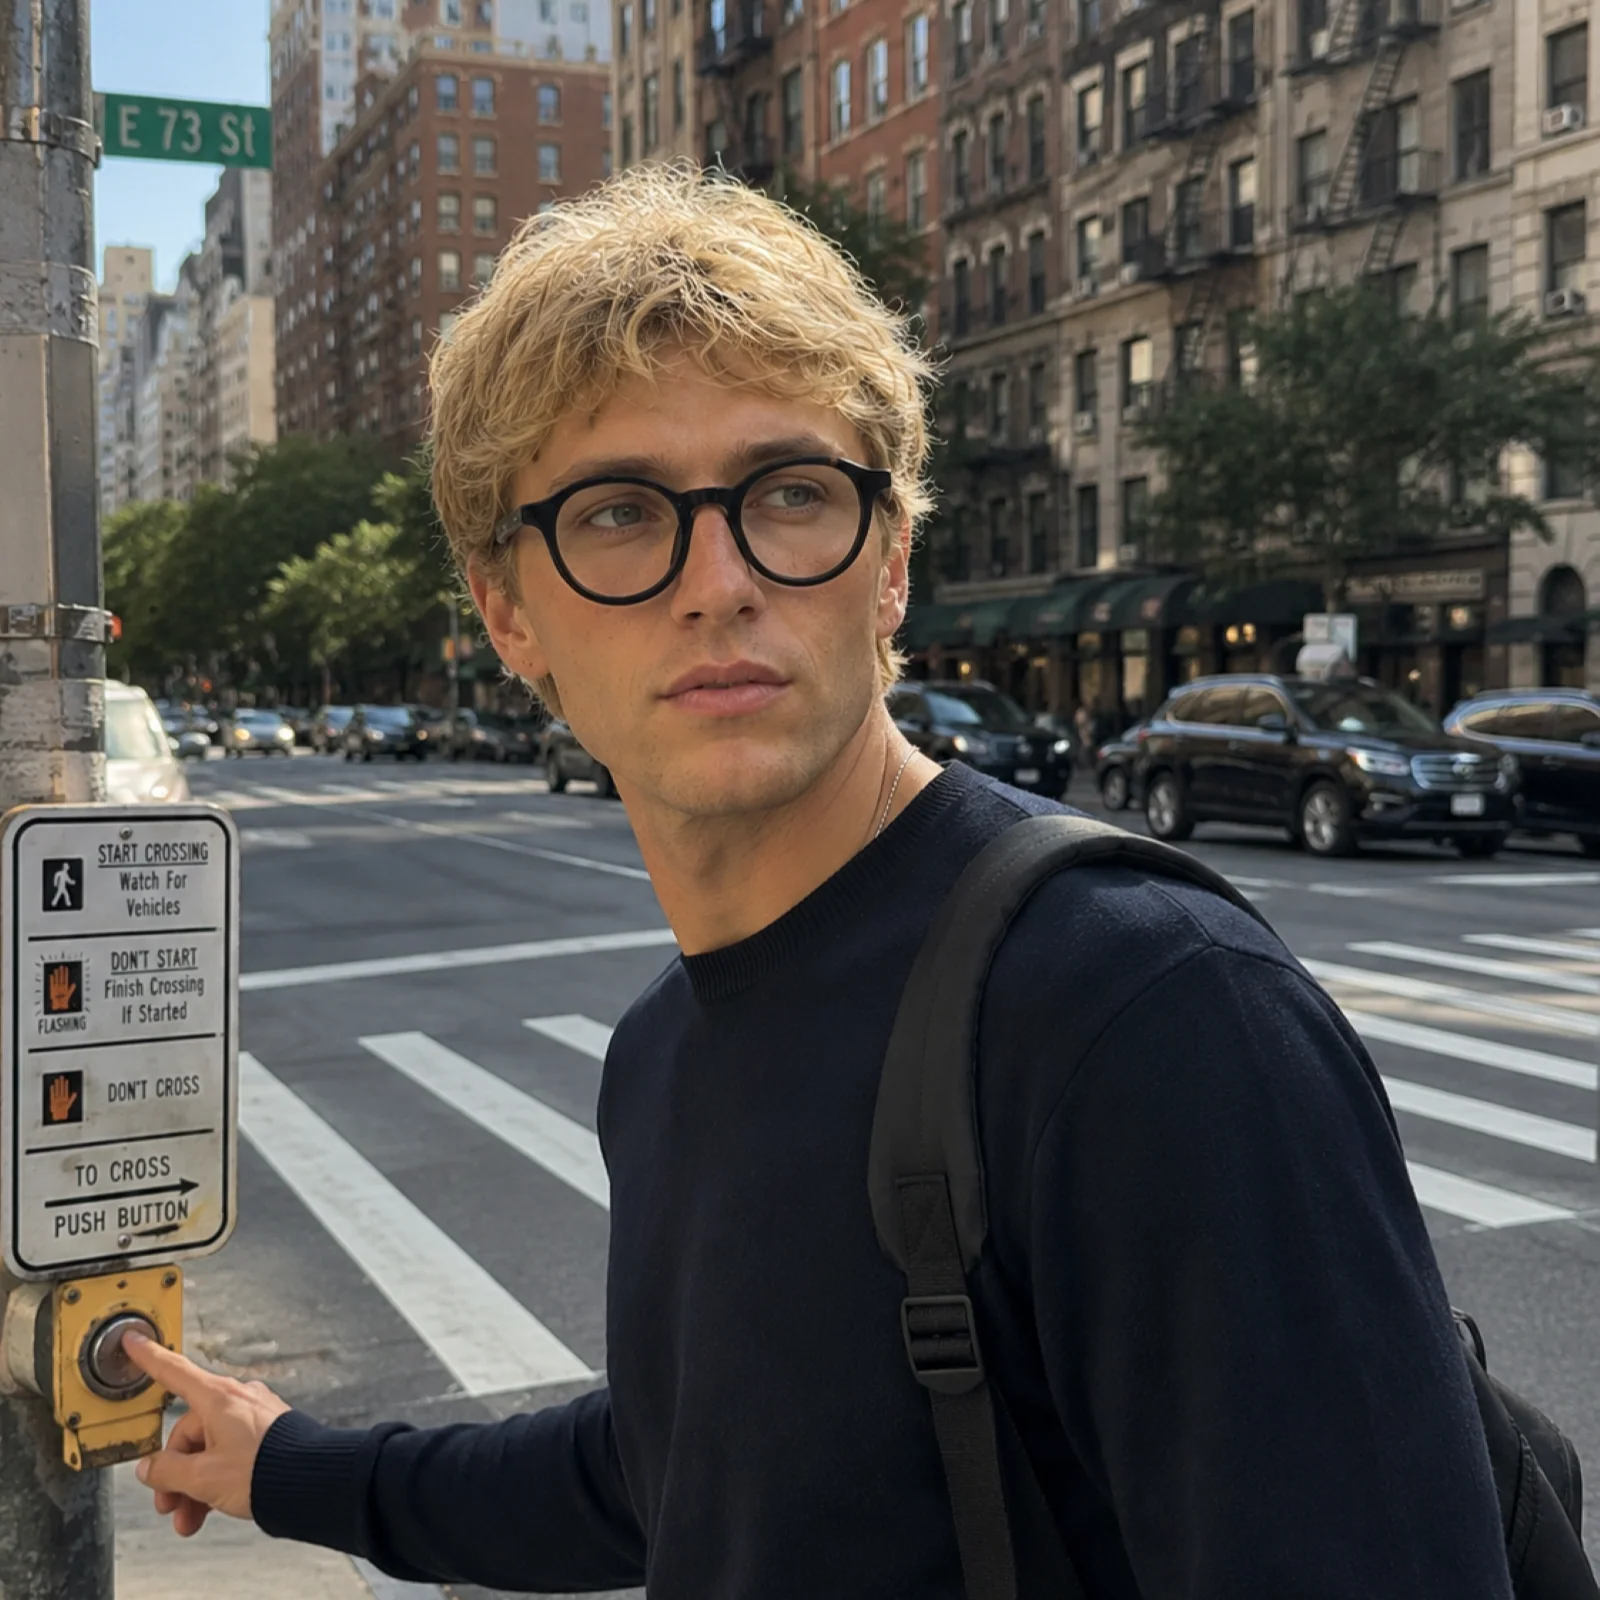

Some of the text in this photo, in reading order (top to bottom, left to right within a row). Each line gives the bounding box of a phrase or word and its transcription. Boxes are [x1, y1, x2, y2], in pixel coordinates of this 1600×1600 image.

[119, 105, 256, 157] E 73 St
[98, 842, 209, 864] START CROSSING
[120, 870, 187, 891] Watch For
[127, 898, 181, 917] Vehicles
[111, 947, 198, 971] DON'T START
[104, 976, 204, 999] Finish Crossing
[122, 1002, 187, 1024] If Started
[38, 1016, 86, 1035] FLASHING
[108, 1075, 200, 1103] DON'T CROSS
[75, 1156, 170, 1187] TO CROSS
[55, 1200, 189, 1238] PUSH BUTTON
